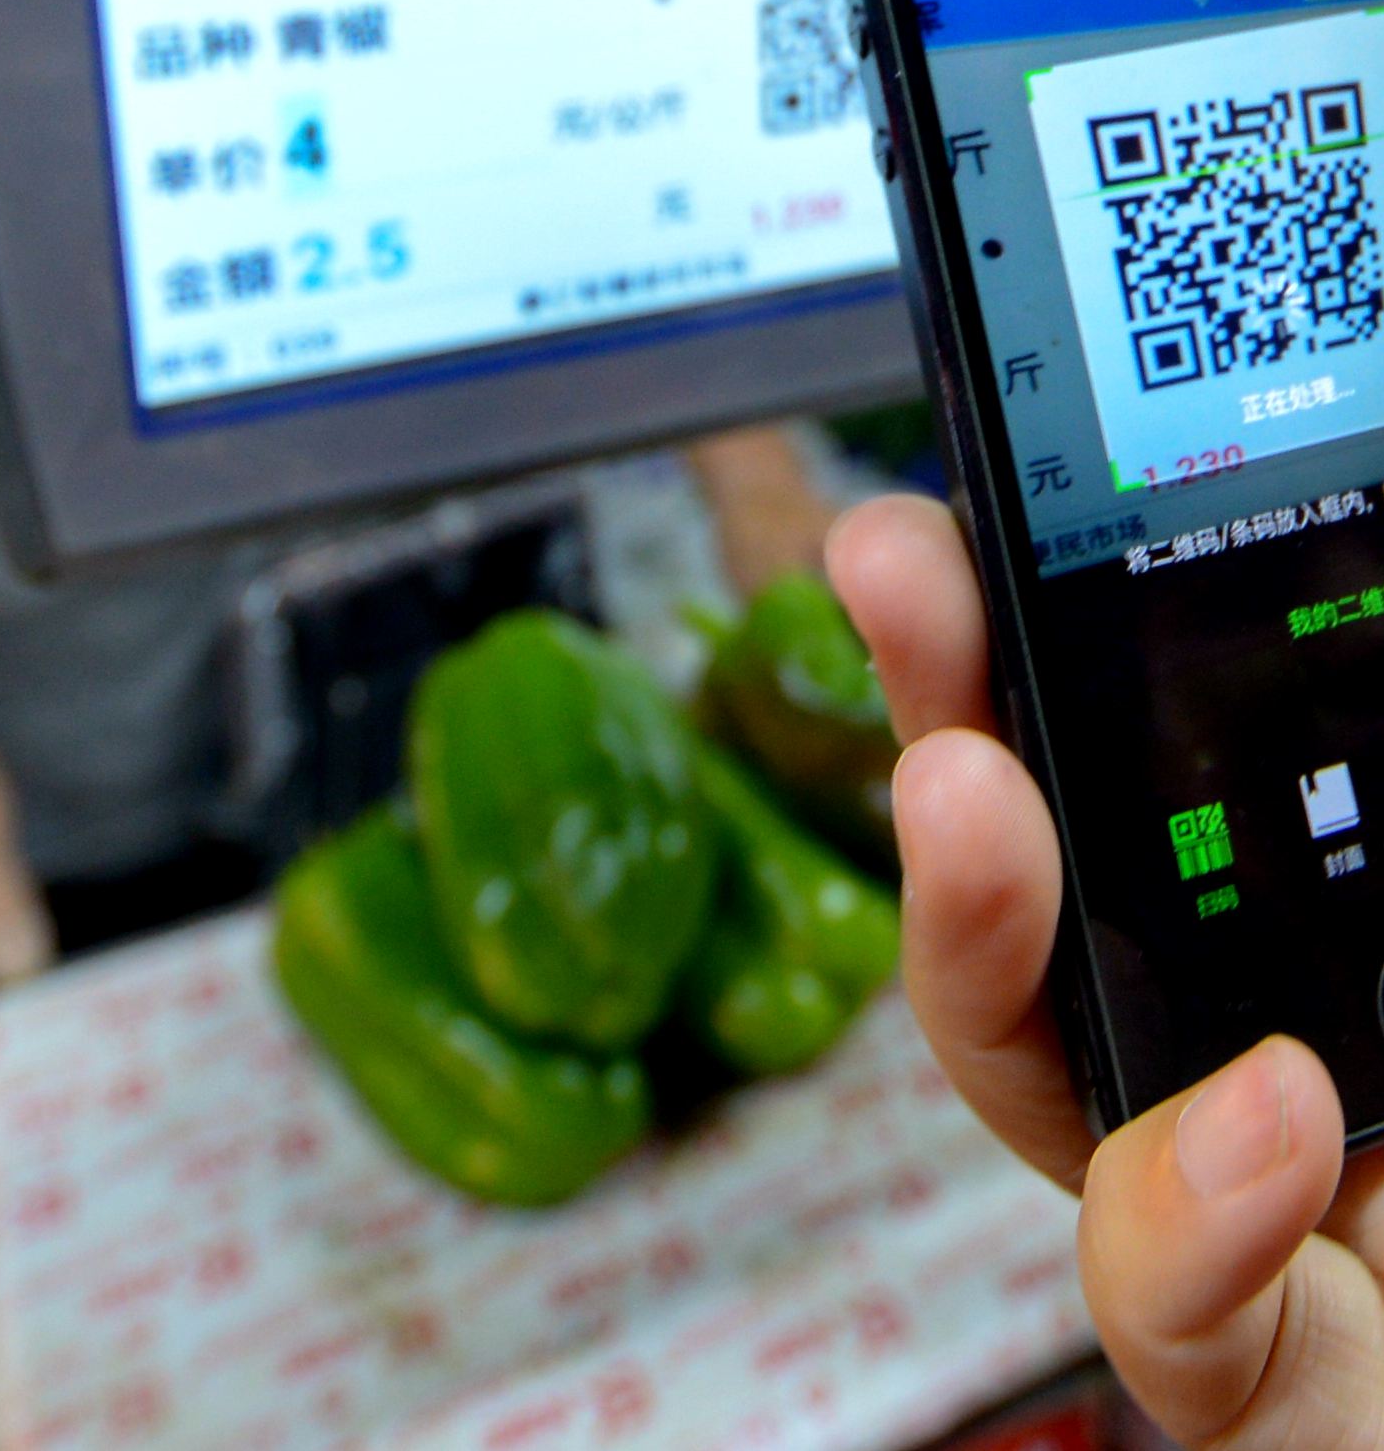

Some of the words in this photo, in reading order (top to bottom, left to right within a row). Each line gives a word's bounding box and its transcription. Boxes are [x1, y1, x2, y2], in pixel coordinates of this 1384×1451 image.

[284, 115, 326, 173] 4
[292, 219, 410, 291] 2.5
[1005, 352, 1046, 396] 斤
[1027, 453, 1073, 497] 元
[1142, 443, 1246, 493] 1.230
